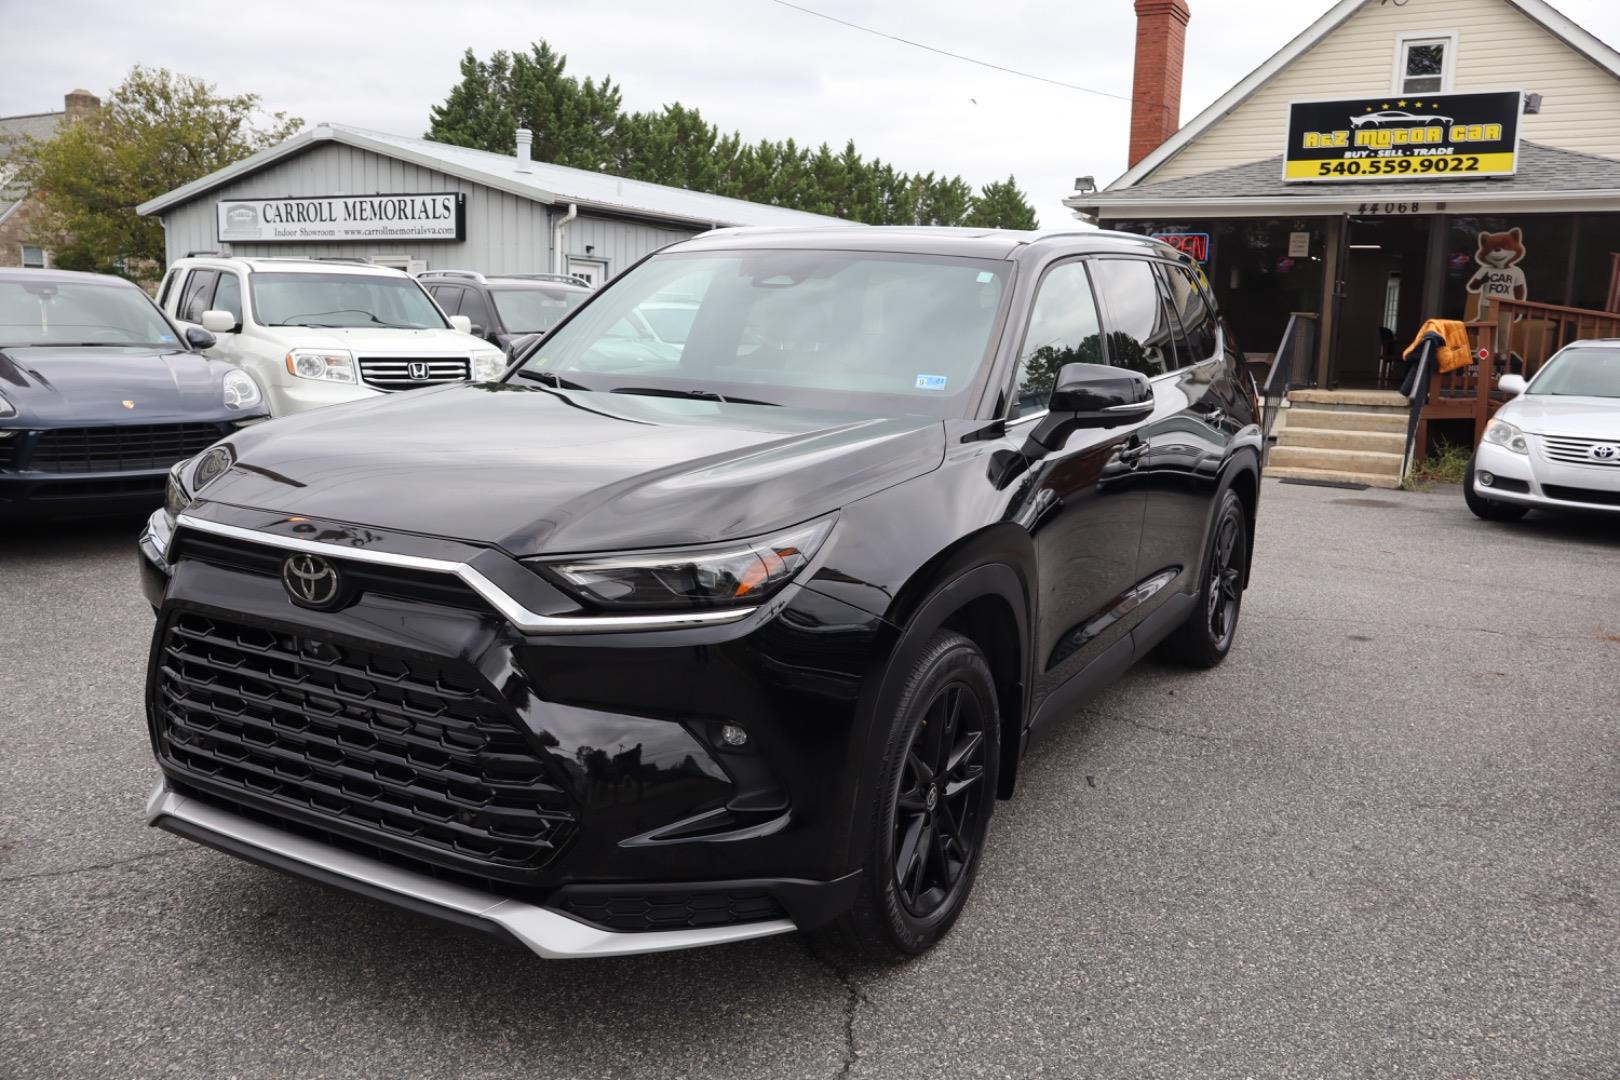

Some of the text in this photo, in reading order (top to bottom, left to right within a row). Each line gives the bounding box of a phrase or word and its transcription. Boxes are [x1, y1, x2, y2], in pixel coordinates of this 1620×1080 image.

[1354, 126, 1443, 149] MOTOR
[1344, 147, 1455, 158] BUY SELL TRADE
[1318, 156, 1480, 176] 540.559.9022
[262, 201, 338, 223] CARROLL
[343, 197, 452, 221] MEMORIALS
[274, 226, 455, 237] Indoor Showroom www.carrollmemorialsva.com
[1490, 273, 1513, 283] CAR
[1488, 284, 1511, 294] FOX
